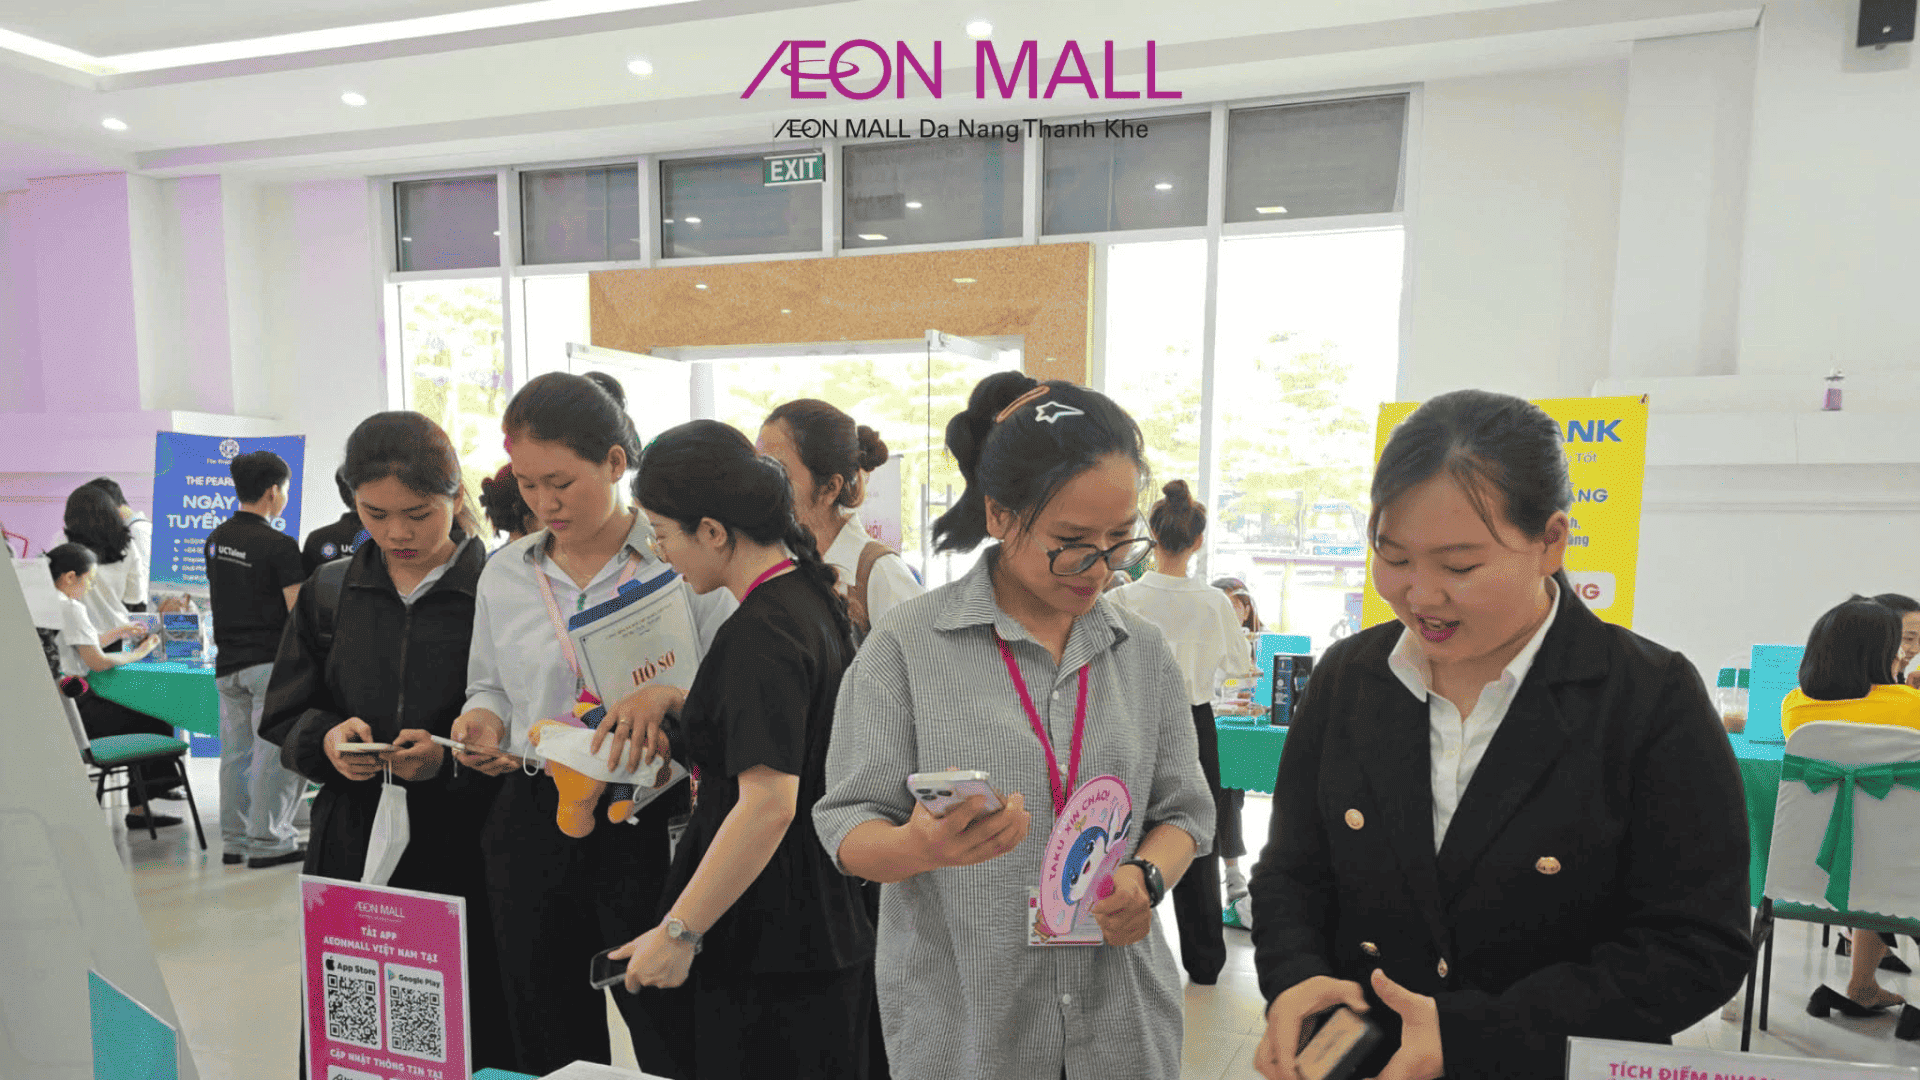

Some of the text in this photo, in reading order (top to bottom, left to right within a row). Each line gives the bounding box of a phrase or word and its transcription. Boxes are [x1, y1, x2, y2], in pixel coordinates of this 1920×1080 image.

[770, 157, 818, 182] EXIT
[1563, 419, 1625, 443] NK
[185, 475, 204, 486] THE
[182, 492, 236, 510] NGÀY
[1049, 839, 1065, 881] TAKU
[1065, 810, 1080, 835] XIN
[380, 904, 405, 919] MALL
[380, 931, 397, 940] APP
[323, 936, 371, 951] AEONMALL
[398, 948, 418, 960] NAM
[337, 962, 377, 976] App Store
[398, 974, 441, 988] Google Play
[406, 1064, 425, 1076] TIN
[1609, 1061, 1652, 1079] TÍCH
